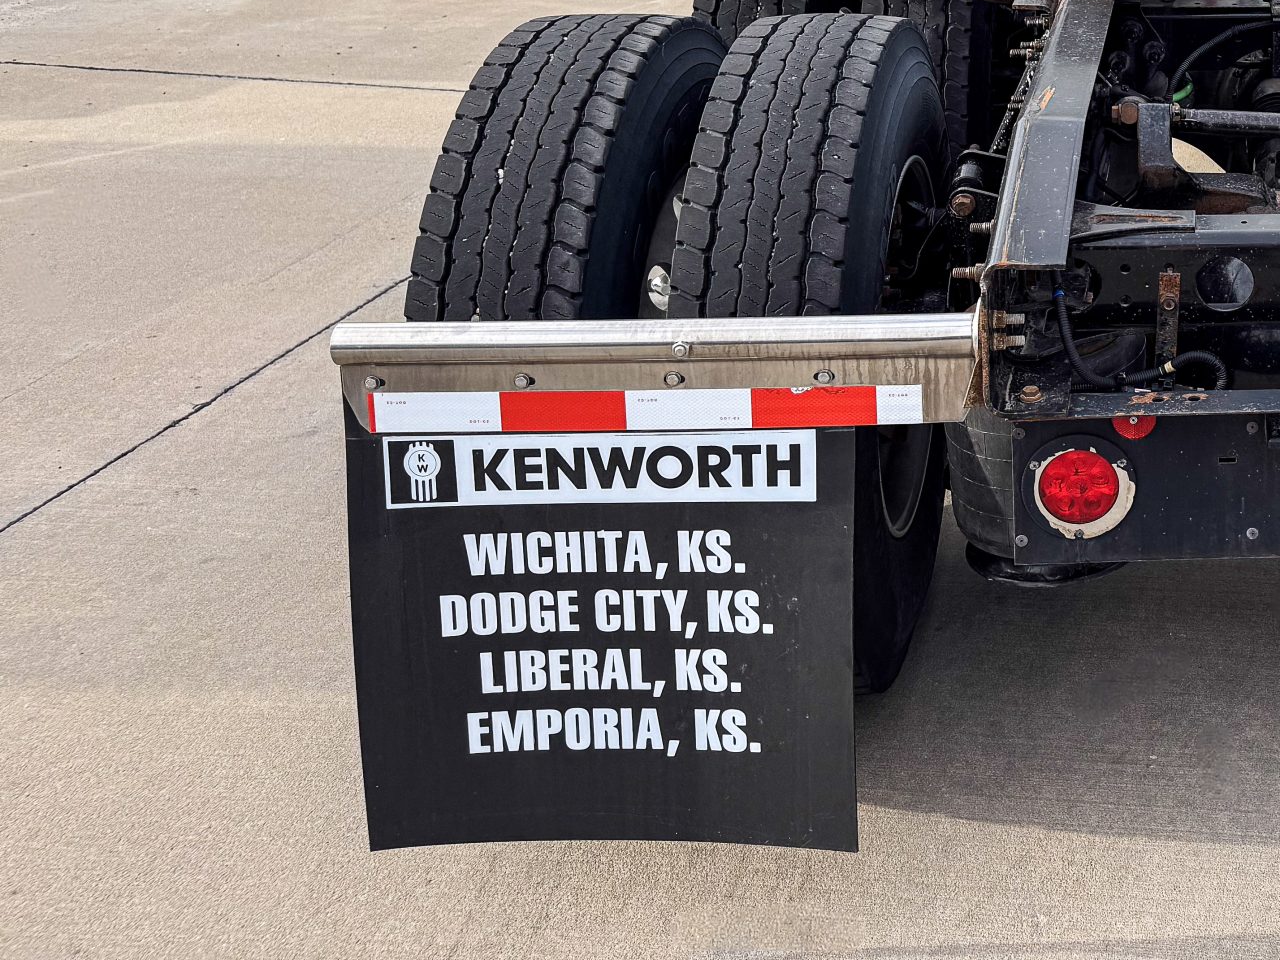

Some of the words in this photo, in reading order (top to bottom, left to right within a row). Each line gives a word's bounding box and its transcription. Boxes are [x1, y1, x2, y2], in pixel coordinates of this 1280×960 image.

[416, 464, 428, 473] W
[418, 453, 425, 463] K
[472, 444, 801, 492] KENWORTH
[464, 530, 669, 580] WICHITA,
[678, 530, 746, 574] KS.
[440, 590, 579, 638] DODGE
[595, 589, 698, 639] CITY,
[707, 589, 774, 635] KS.
[480, 648, 666, 698] LIBERAL,
[675, 648, 742, 693] KS.
[467, 707, 680, 757] EMPORIA,
[695, 708, 762, 753] KS.
